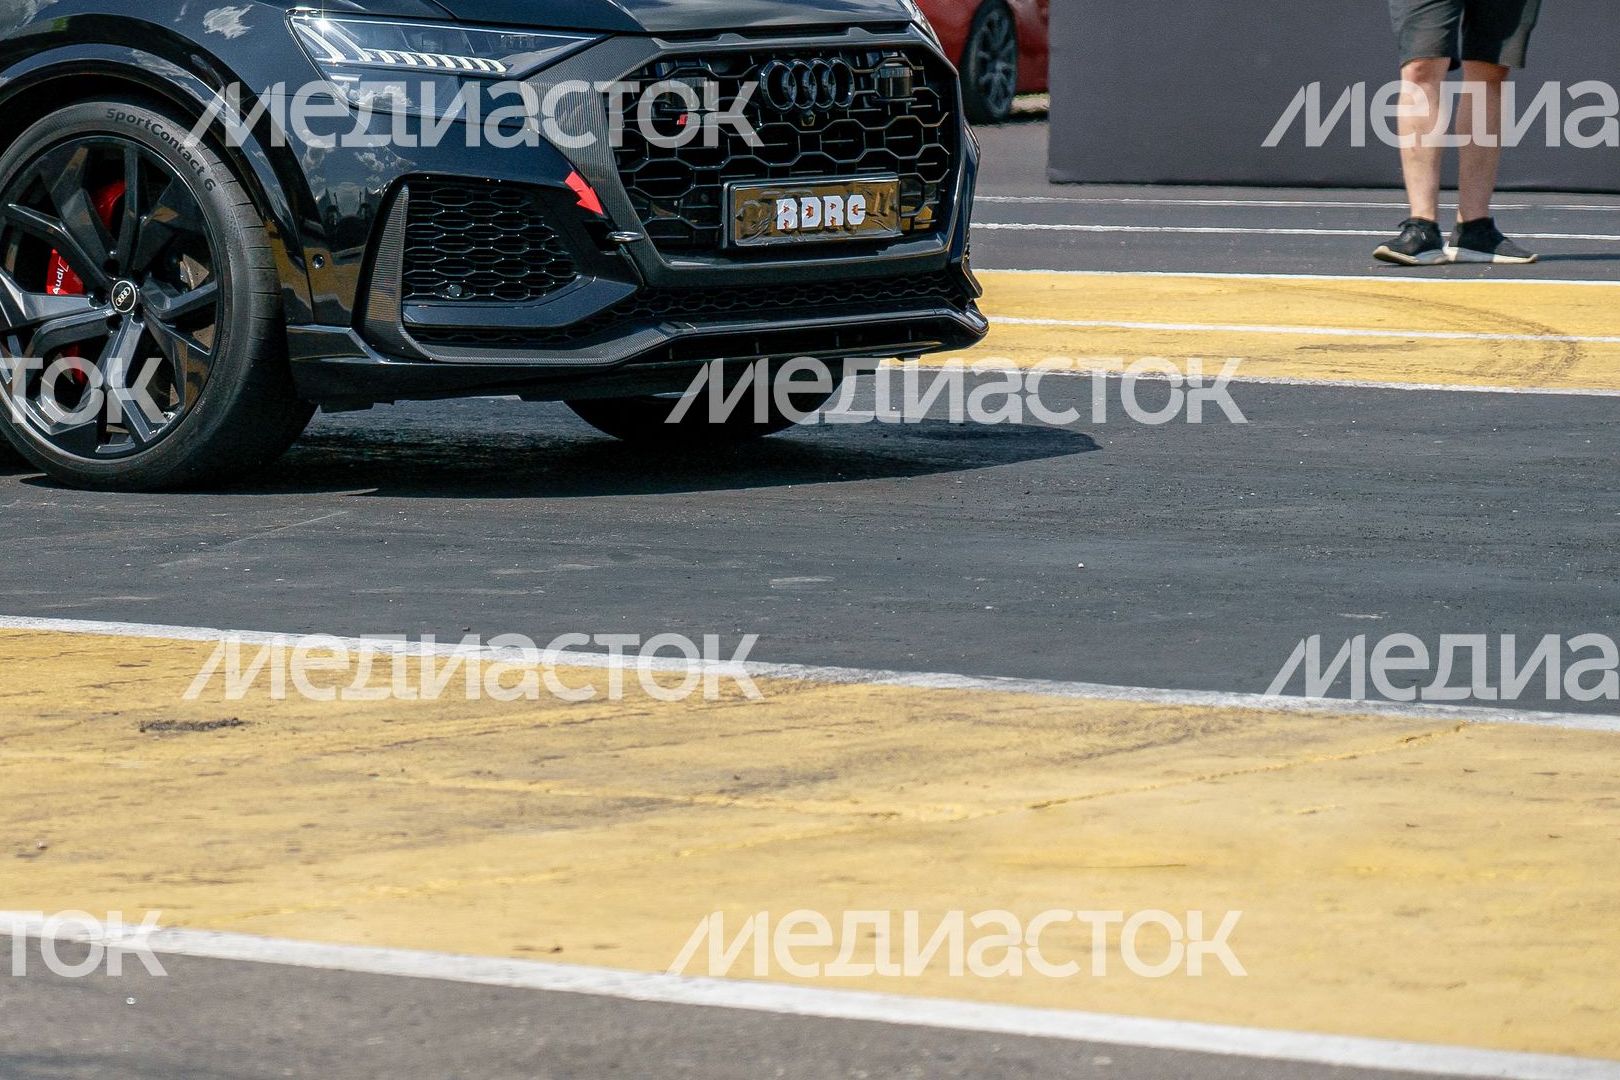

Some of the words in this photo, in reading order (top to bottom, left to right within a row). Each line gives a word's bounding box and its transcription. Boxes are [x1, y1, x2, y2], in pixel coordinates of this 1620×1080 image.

[105, 107, 206, 177] SportContact
[204, 178, 216, 192] 6
[776, 194, 867, 230] RDRC
